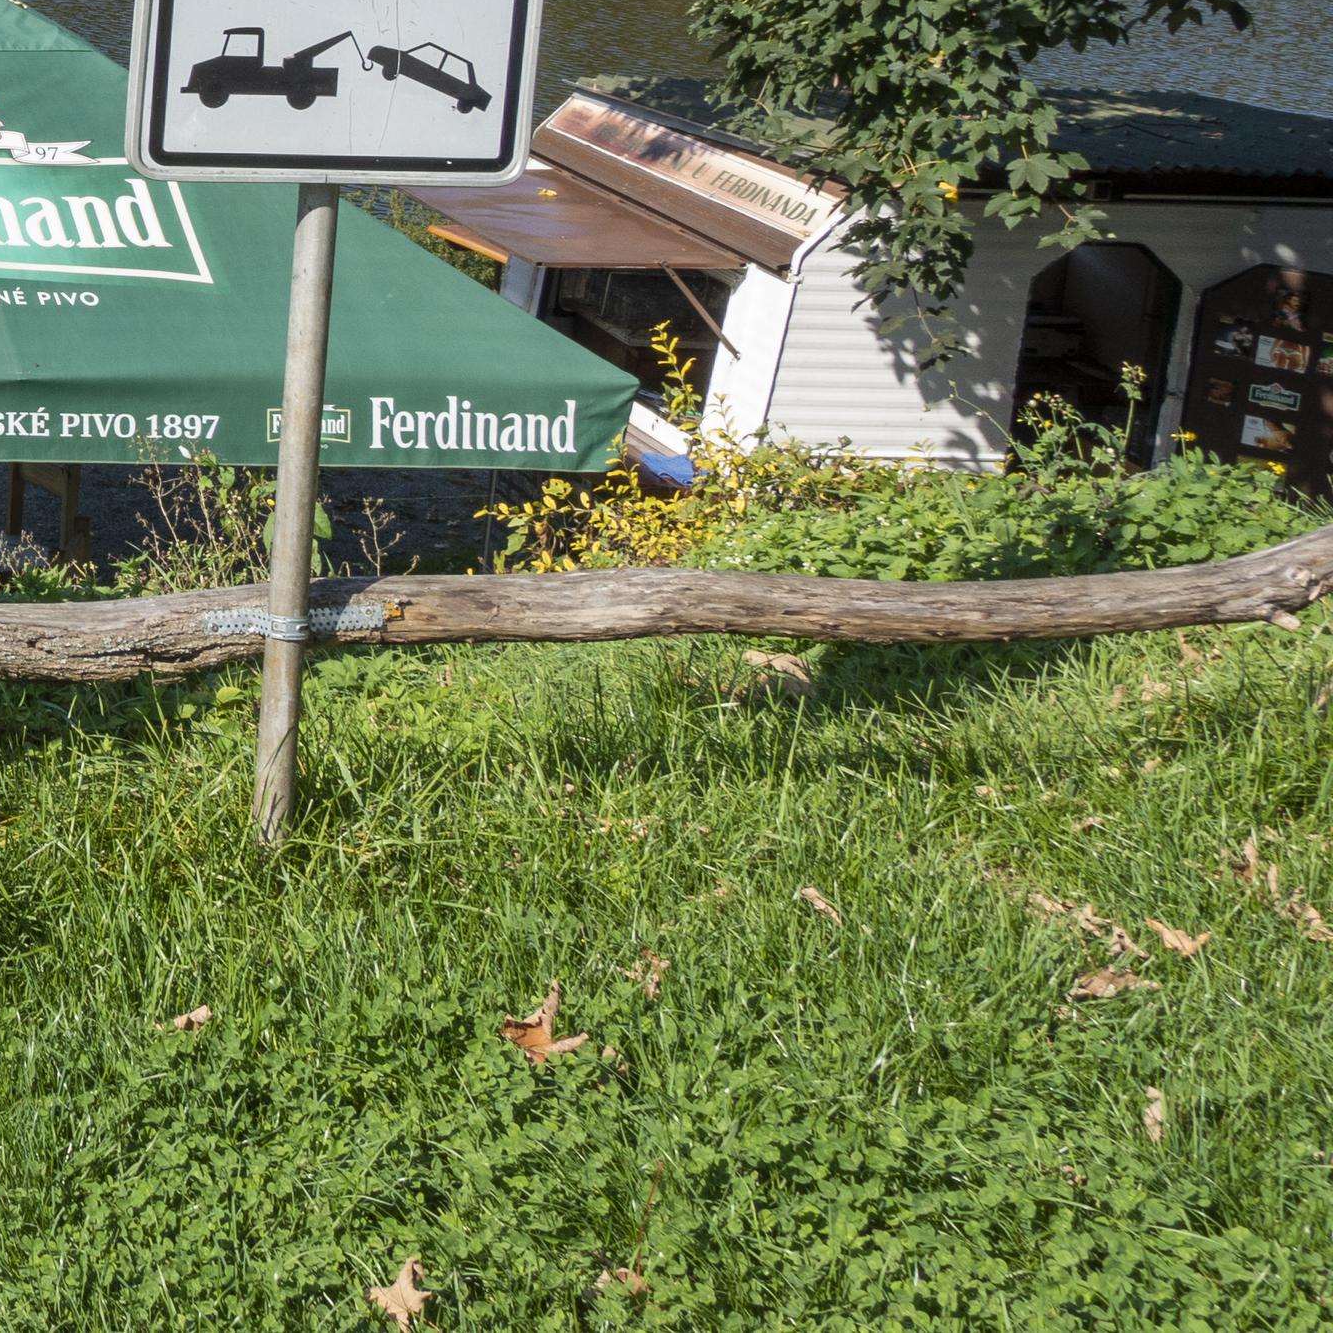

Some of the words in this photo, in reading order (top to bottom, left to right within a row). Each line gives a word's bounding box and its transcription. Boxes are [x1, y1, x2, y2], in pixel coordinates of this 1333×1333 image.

[34, 146, 59, 161] 97
[710, 170, 818, 226] FERDINANDA
[38, 290, 100, 307] PIVO
[60, 413, 136, 438] PIVO
[146, 414, 220, 440] 1897
[369, 395, 578, 454] Ferdinand
